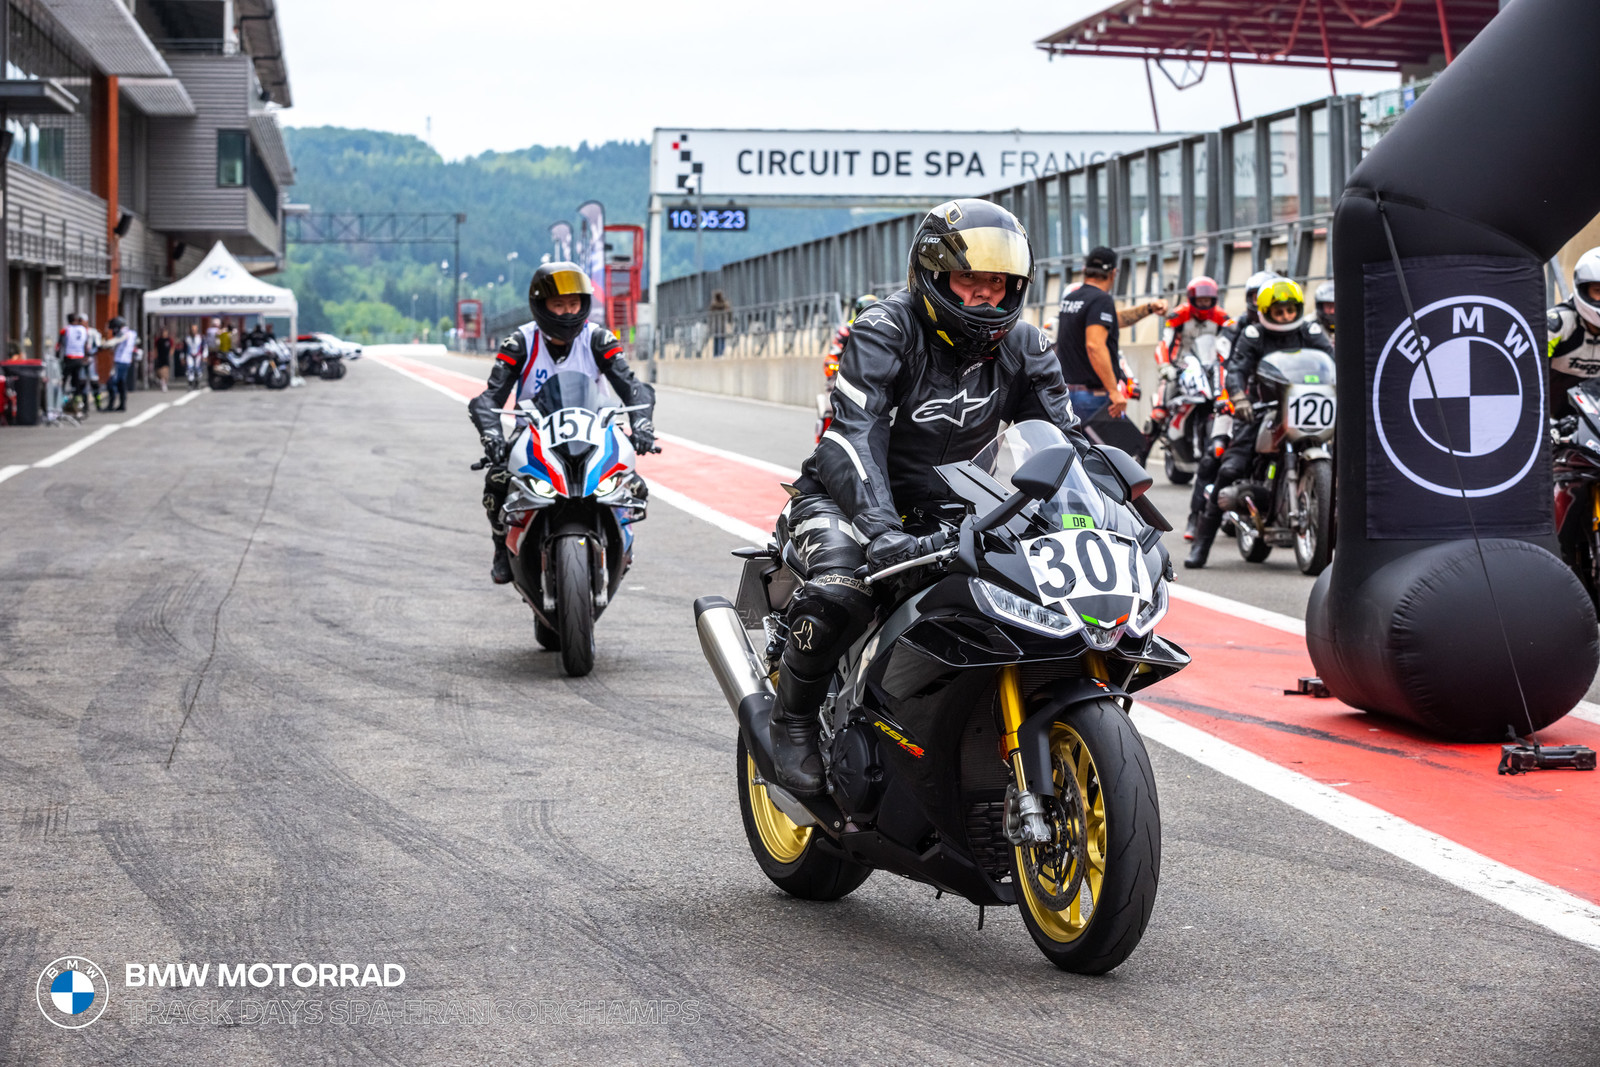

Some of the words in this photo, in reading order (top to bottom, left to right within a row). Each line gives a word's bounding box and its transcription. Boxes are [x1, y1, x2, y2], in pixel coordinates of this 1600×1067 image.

[737, 150, 860, 175] CIRCUIT
[872, 150, 912, 176] DE
[924, 151, 986, 177] SPA
[160, 296, 195, 306] BMW
[198, 295, 276, 305] MOTORRAD
[1396, 306, 1531, 364] BMW
[542, 409, 596, 445] 157
[1289, 398, 1334, 427] 120
[1072, 516, 1087, 528] DB
[1029, 530, 1141, 598] 307
